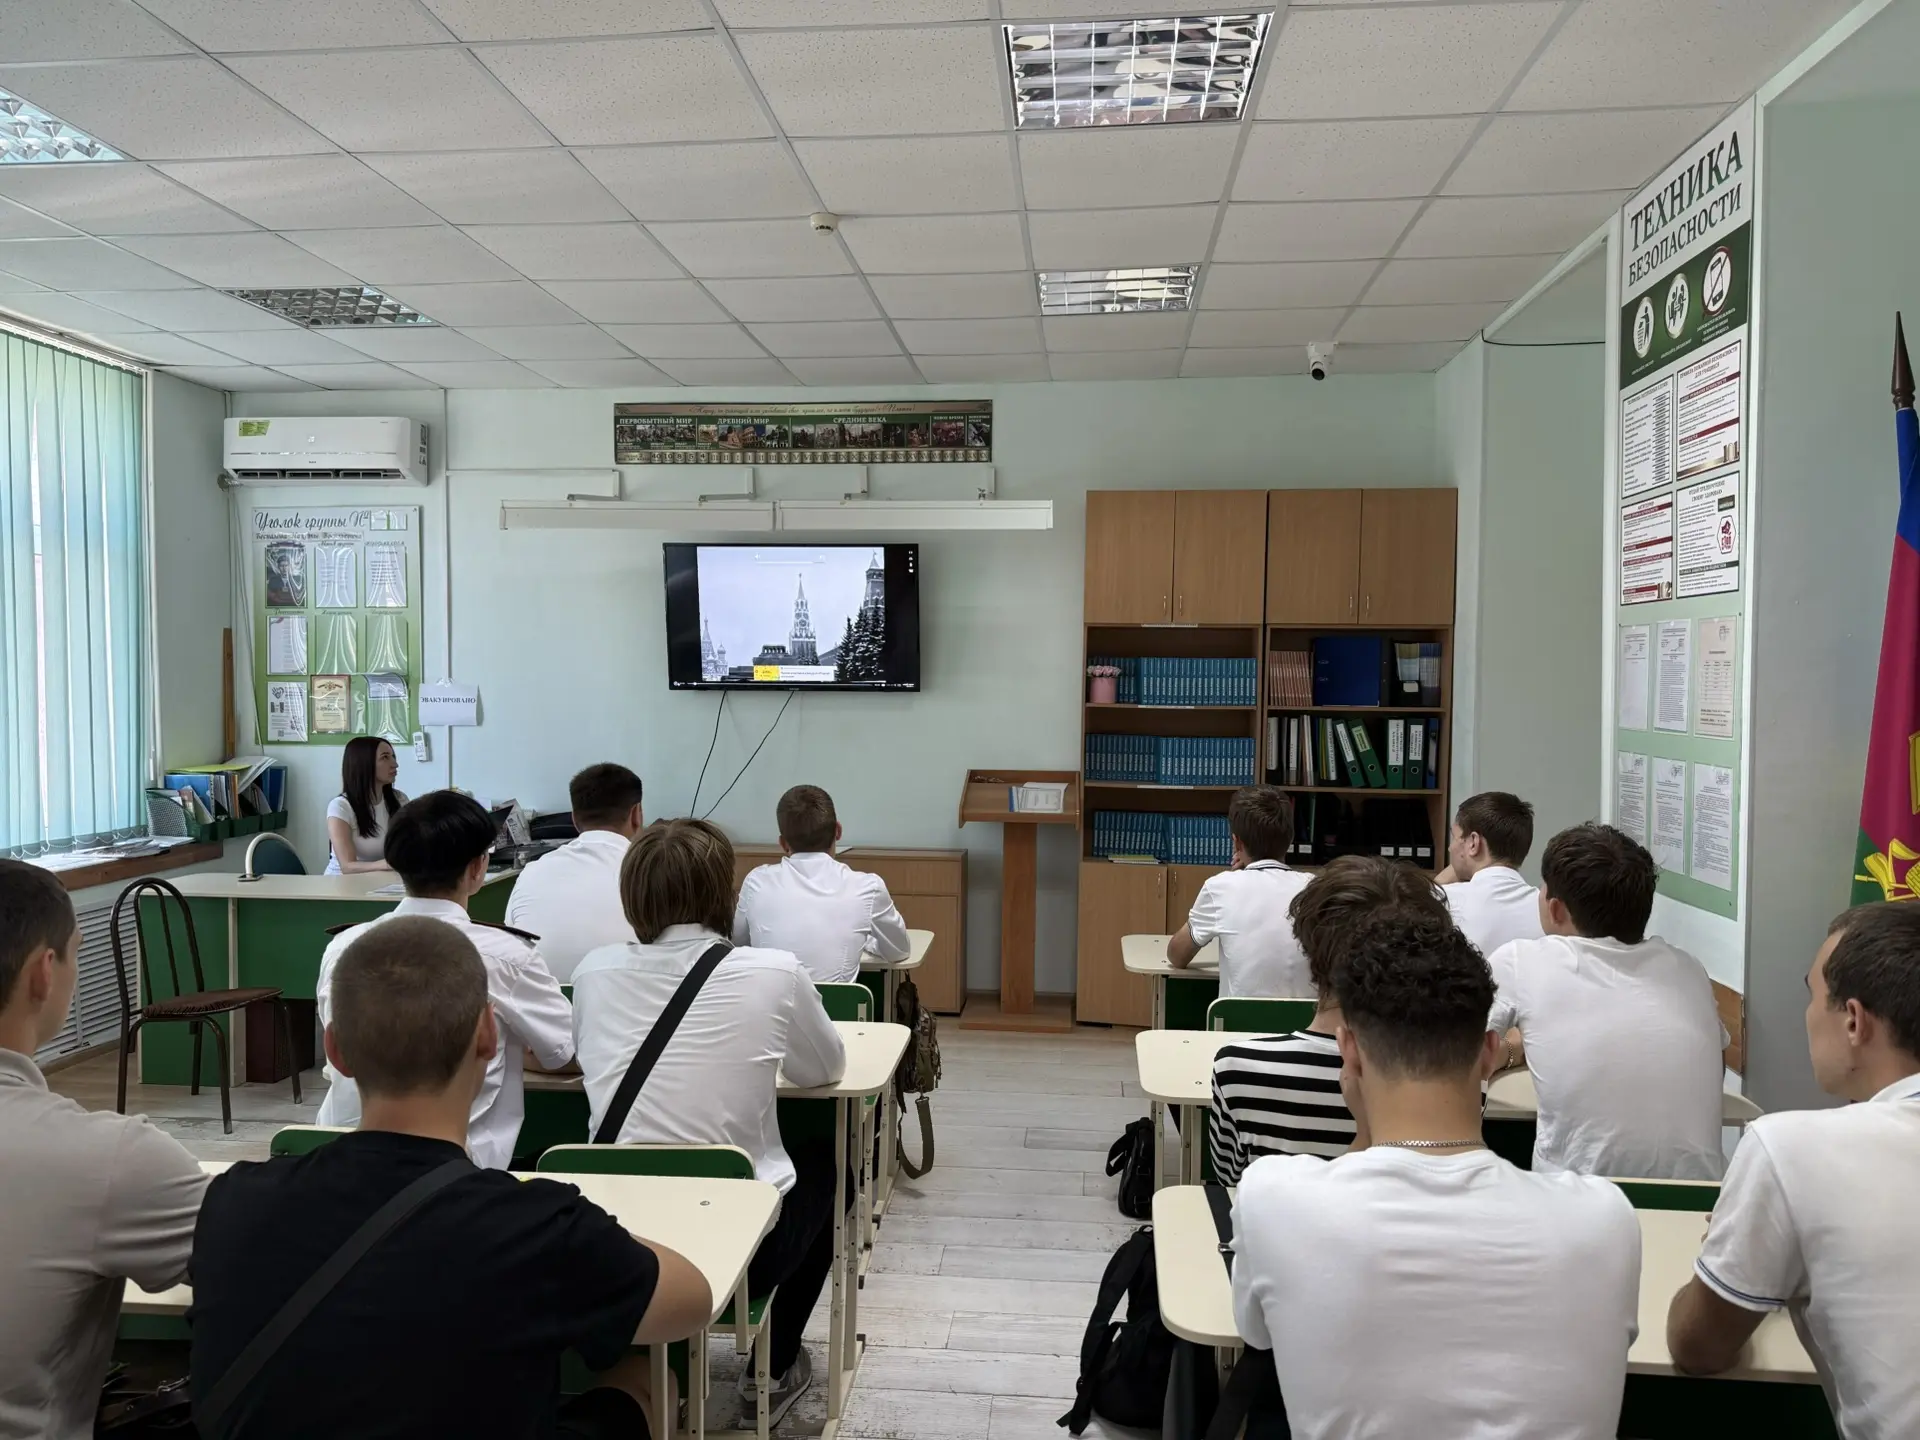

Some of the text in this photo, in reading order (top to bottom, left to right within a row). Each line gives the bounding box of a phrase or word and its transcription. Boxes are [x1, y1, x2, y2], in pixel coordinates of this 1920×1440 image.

[1630, 130, 1743, 252] ТЕХНИКА
[1628, 183, 1742, 287] БЕЗОПАСНОСТИ
[619, 417, 675, 425] ПЕРВОБЫТНЫЙ
[717, 417, 752, 425] ДРЕВНИЙ
[833, 416, 867, 424] СРЕДНИЕ
[254, 510, 369, 531] Уголок группы №
[420, 696, 476, 704] ЭВАКУИРОВАНО
